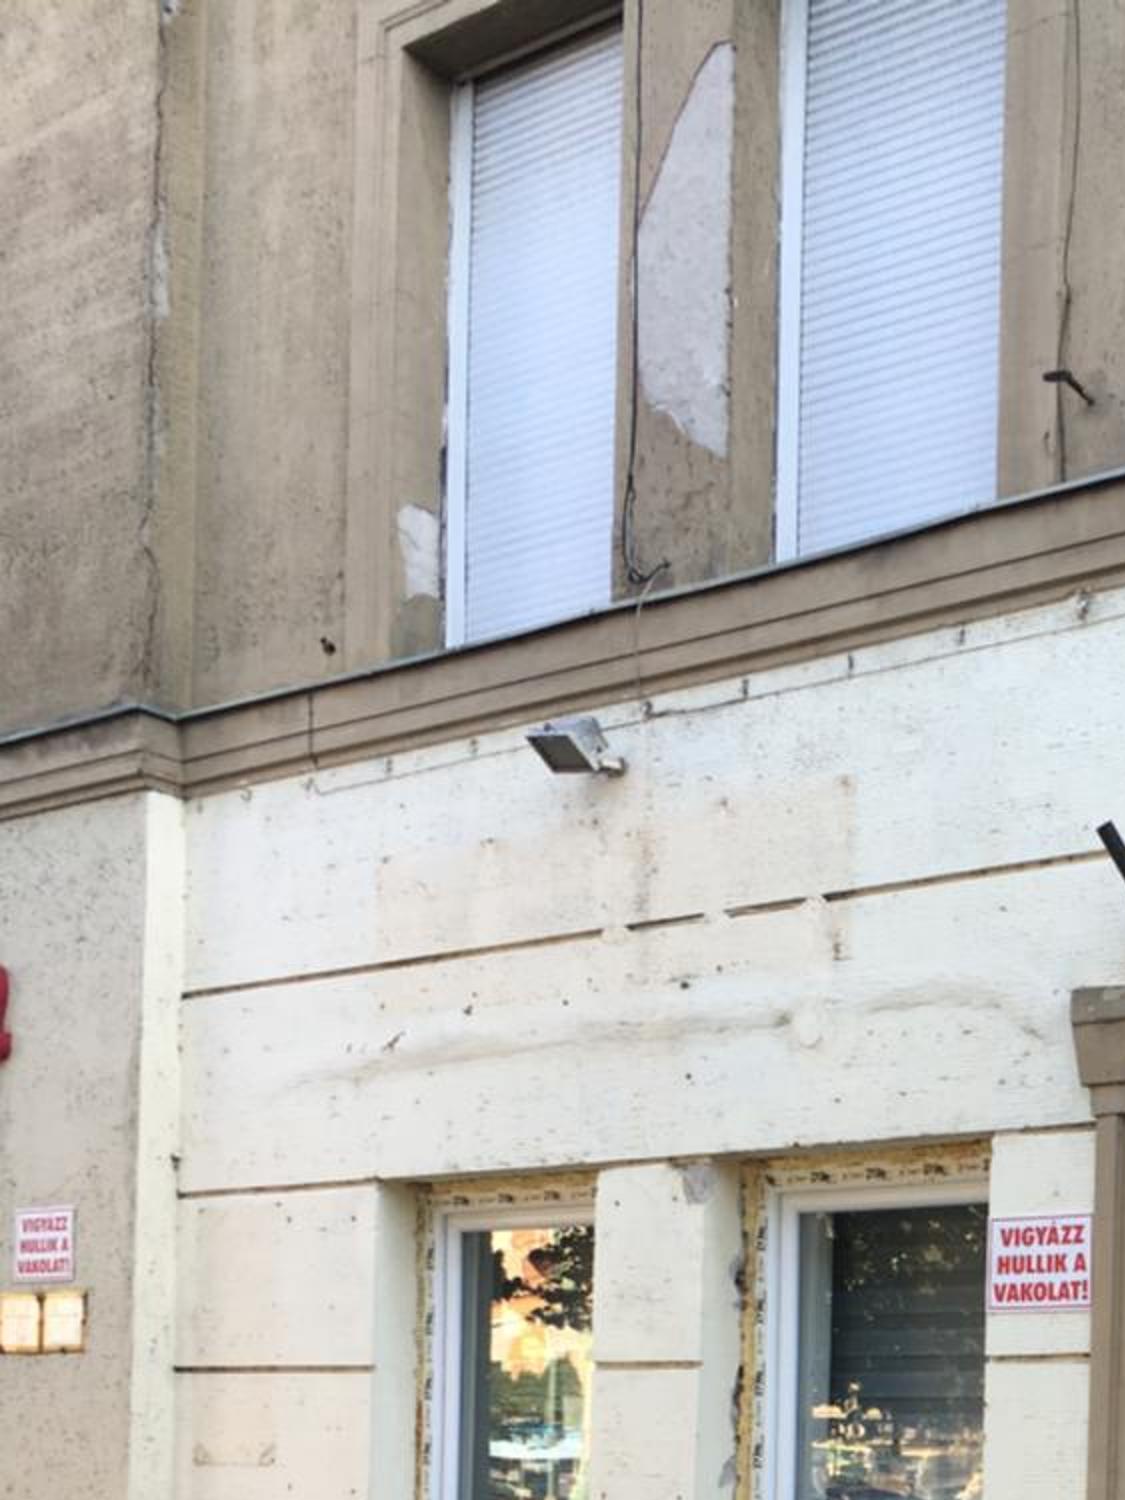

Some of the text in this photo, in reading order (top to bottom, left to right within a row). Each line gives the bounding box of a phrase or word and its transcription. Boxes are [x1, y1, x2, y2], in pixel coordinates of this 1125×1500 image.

[1000, 1225, 1084, 1247] VIGYAZZ
[997, 1252, 1086, 1275] HULLIK A
[993, 1280, 1088, 1302] VAKOLAT!
